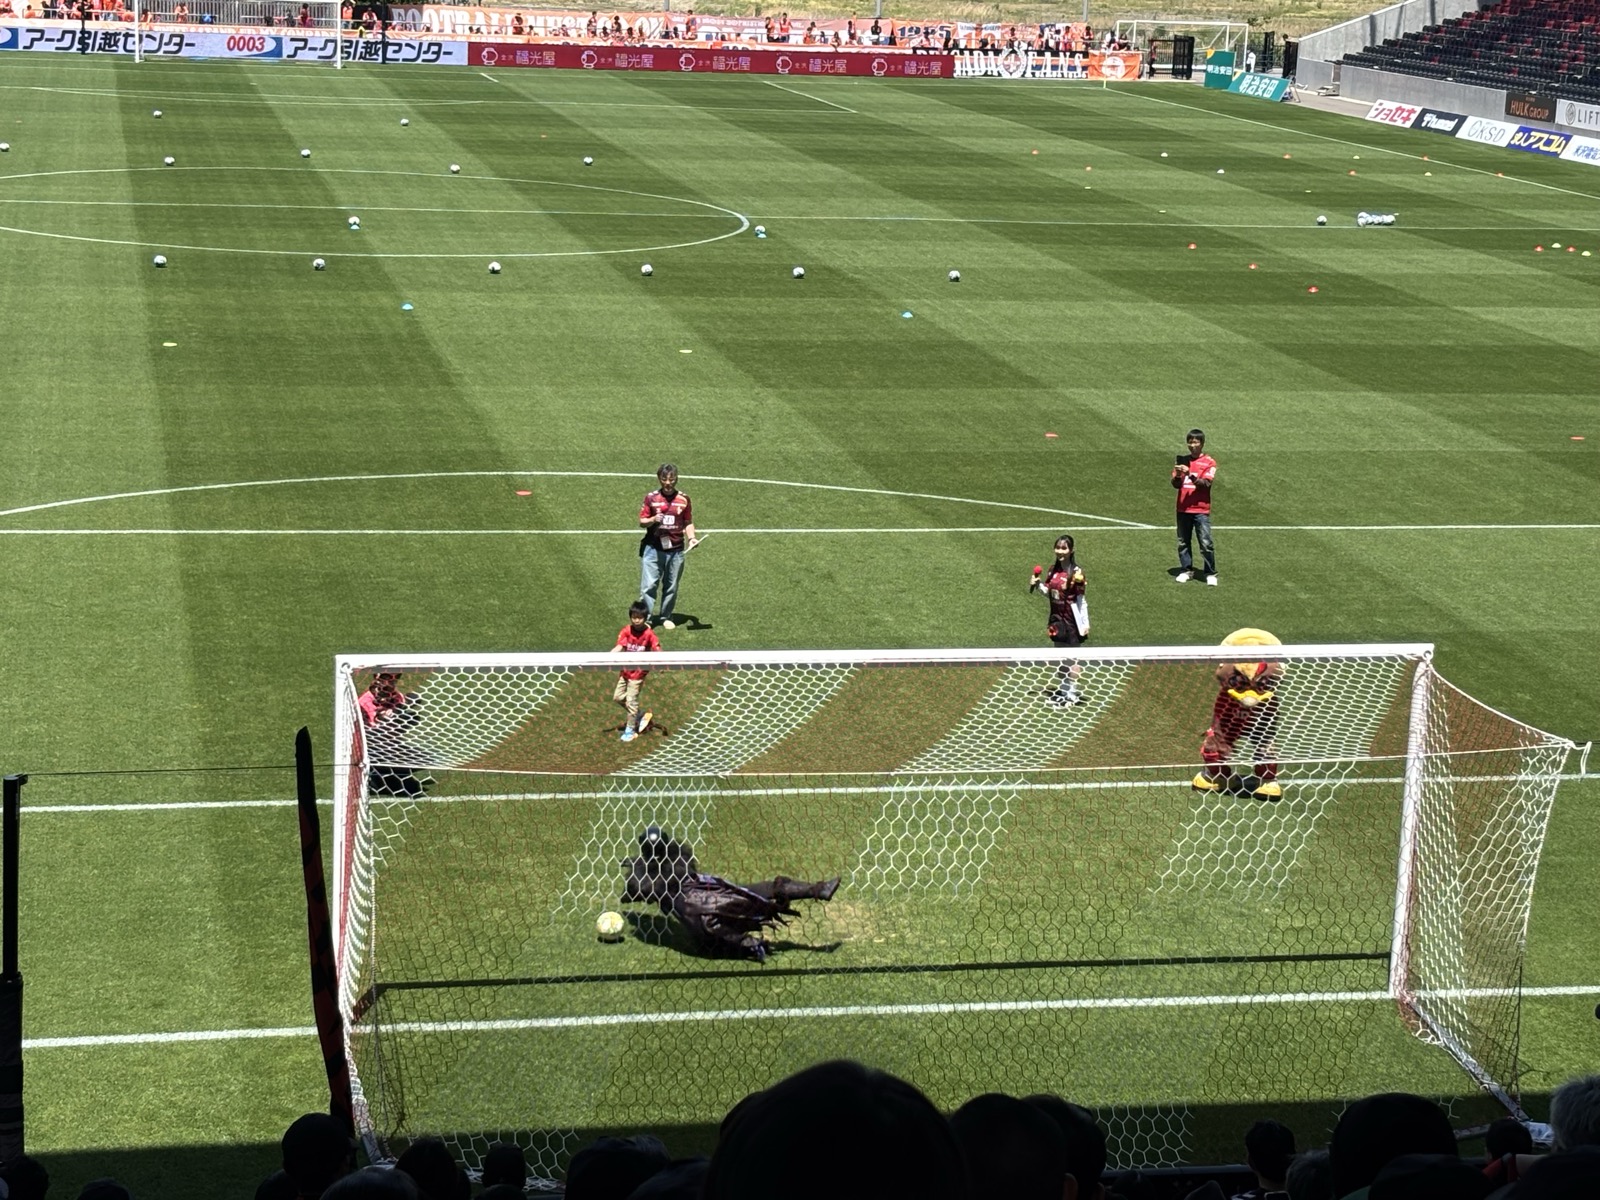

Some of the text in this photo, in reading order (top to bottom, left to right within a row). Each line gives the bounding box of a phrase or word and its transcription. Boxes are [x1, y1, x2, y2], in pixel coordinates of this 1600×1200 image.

[23, 28, 196, 55] アーク引越センター
[226, 35, 265, 52] 0003
[286, 37, 453, 63] アーク引越センター
[515, 50, 556, 66] 福光屋
[614, 52, 654, 69] 福光屋
[712, 55, 751, 71] 福光屋
[808, 58, 847, 73] 福光屋
[904, 61, 942, 75] 福光屋
[1206, 65, 1233, 76] 明治安田
[1239, 74, 1279, 98] 明治安田
[1369, 102, 1417, 125] ショセキ
[1510, 100, 1550, 119] HULK GROUP
